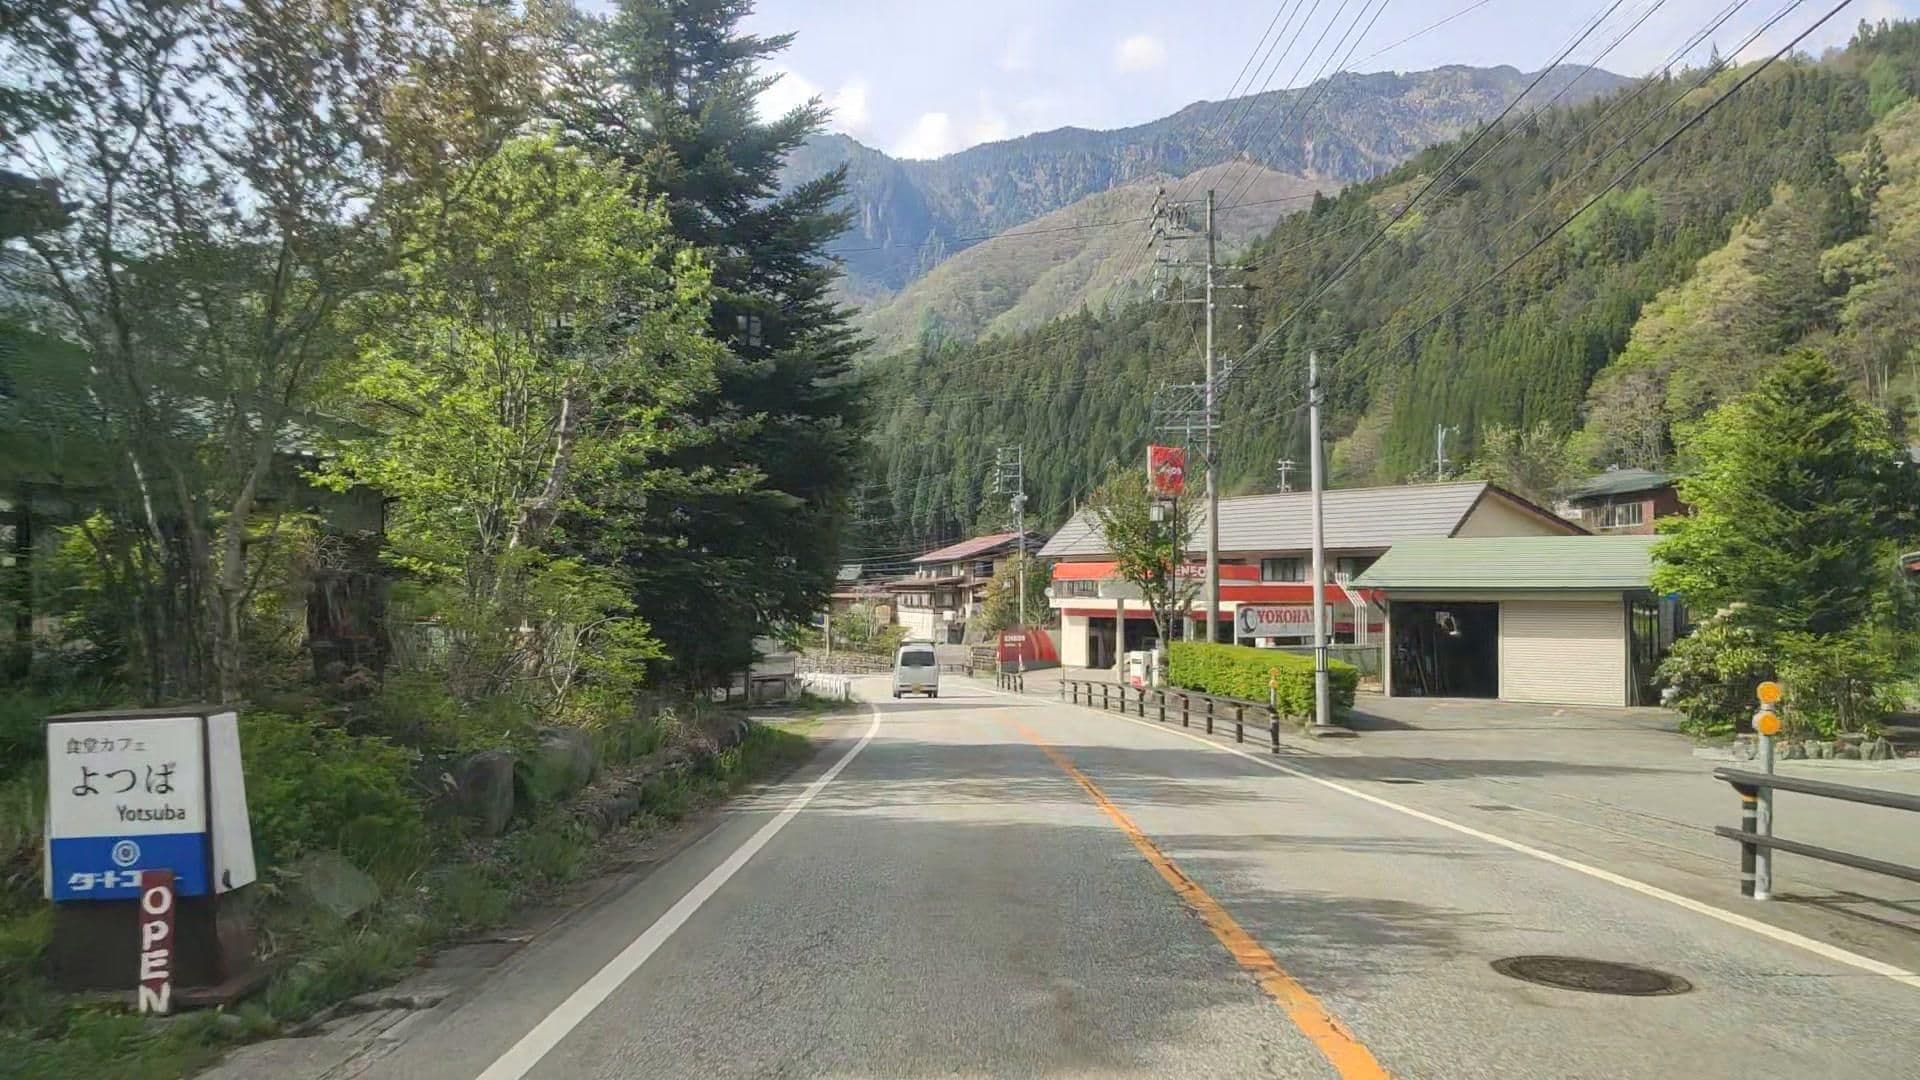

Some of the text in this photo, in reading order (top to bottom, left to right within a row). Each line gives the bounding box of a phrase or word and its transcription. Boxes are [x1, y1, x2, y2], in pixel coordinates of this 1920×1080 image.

[1257, 609, 1328, 624] YOKOHA
[66, 737, 146, 754] 食堂カフェ
[71, 762, 177, 797] よつば
[116, 804, 185, 822] Yotsuba
[138, 886, 172, 1013] OPEN
